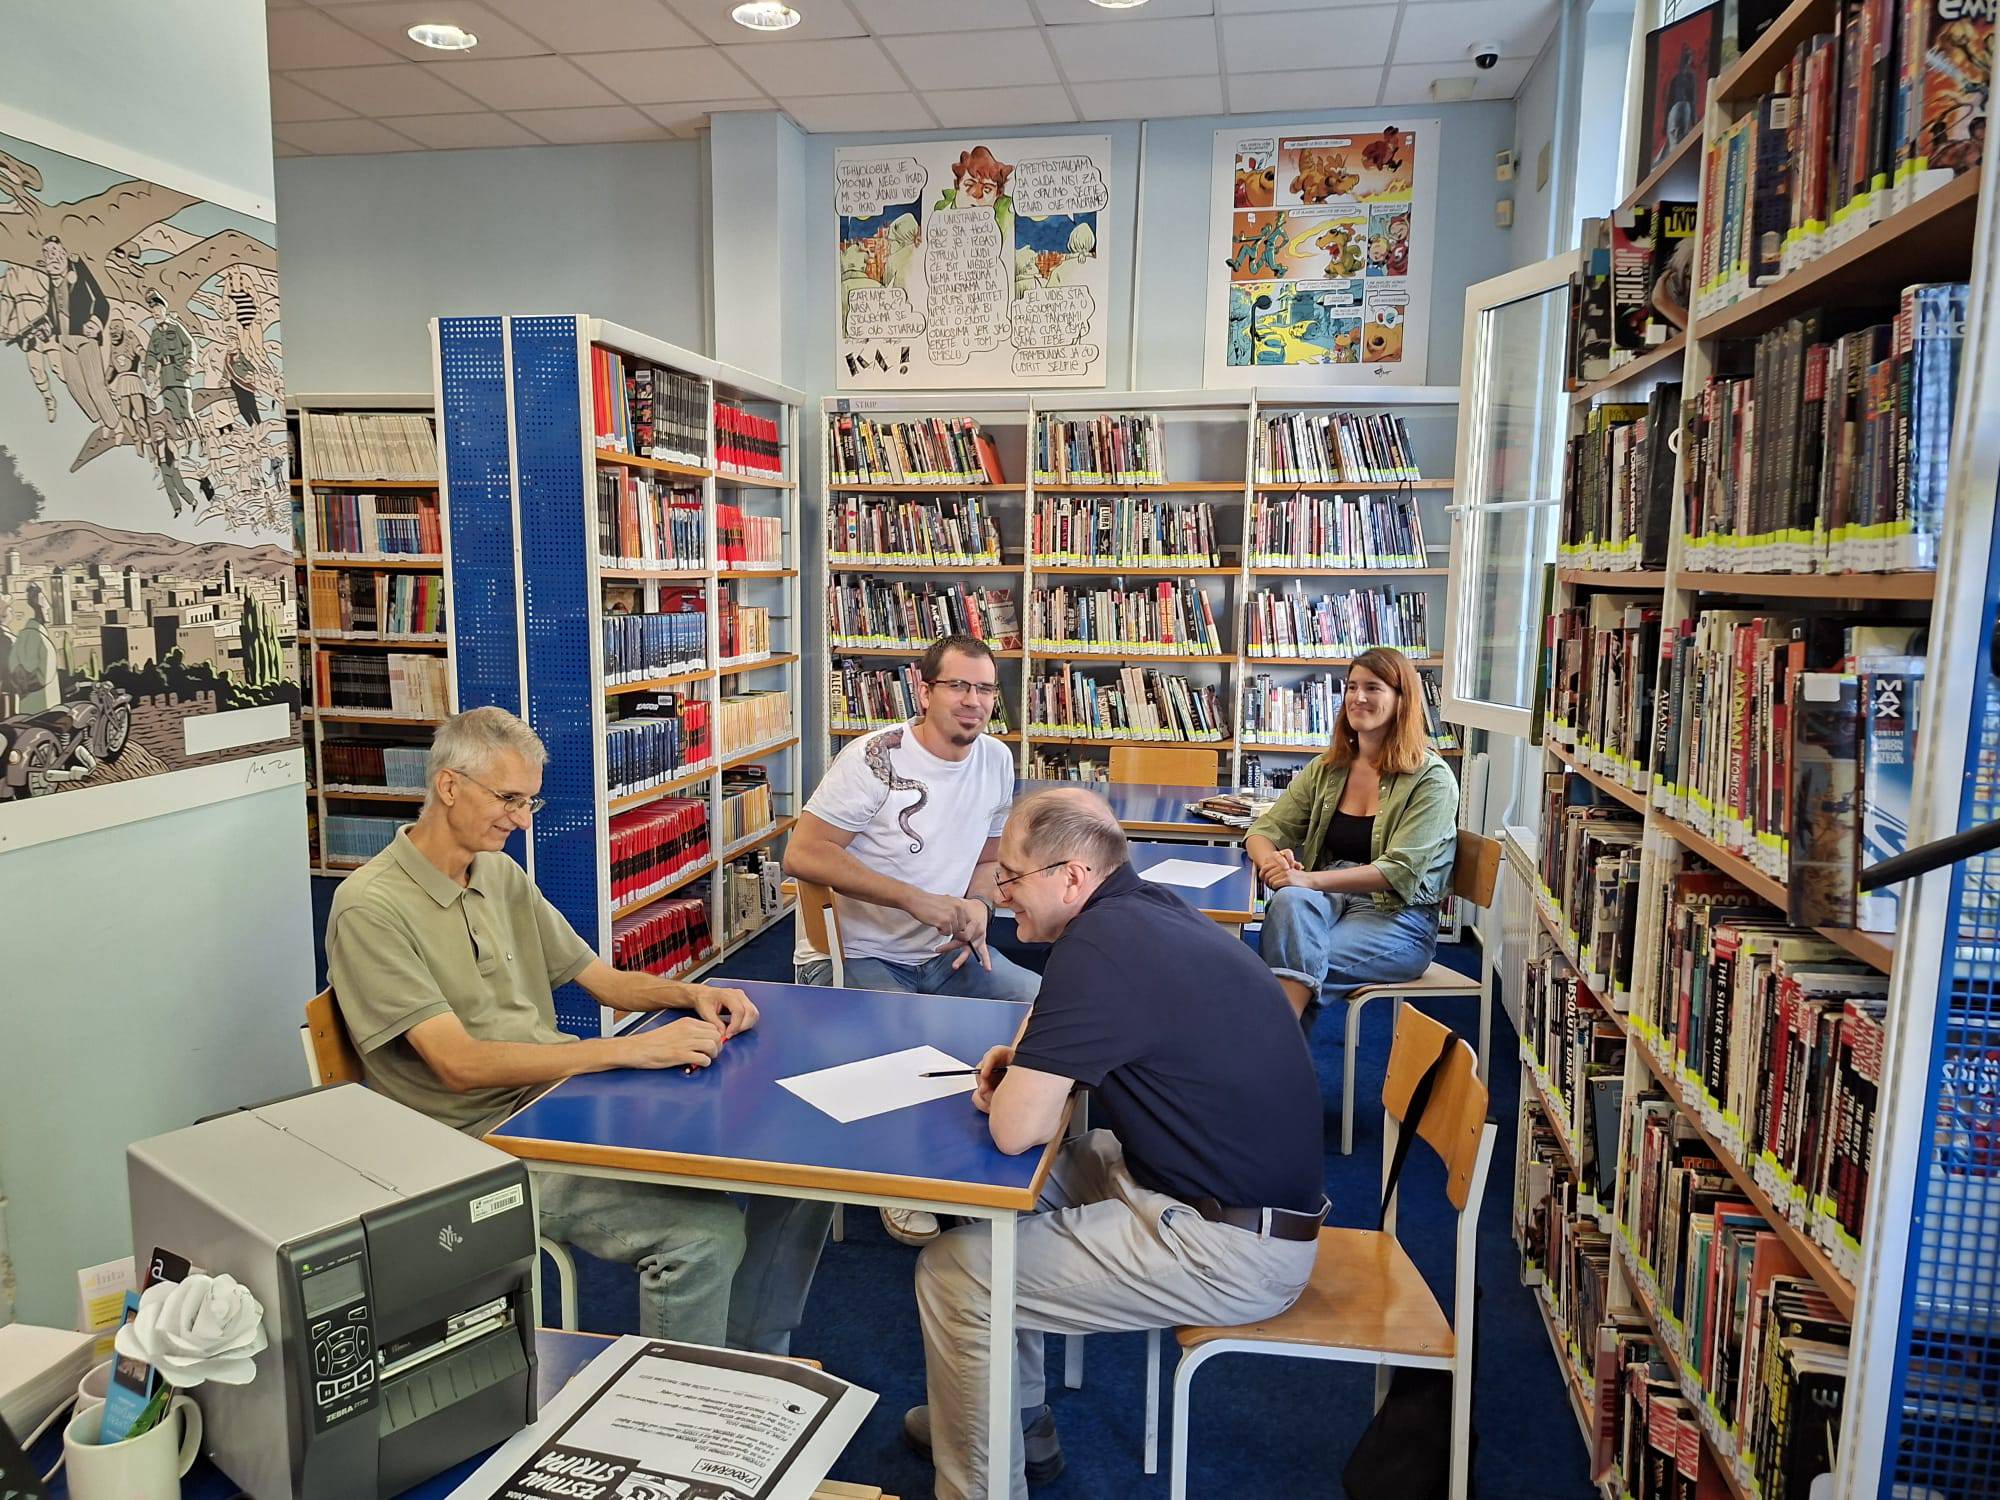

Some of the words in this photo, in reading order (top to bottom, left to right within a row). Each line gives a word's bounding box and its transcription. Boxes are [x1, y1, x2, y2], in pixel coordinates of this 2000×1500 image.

[897, 162, 907, 172] JE
[879, 176, 900, 188] NEGO
[1018, 178, 1028, 188] DA
[1062, 174, 1078, 185] NISI
[1082, 172, 1096, 184] ZA
[841, 191, 849, 202] MI
[853, 191, 870, 200] SMO
[1017, 190, 1029, 200] DA
[841, 203, 853, 213] NO
[986, 280, 997, 291] DA
[1615, 248, 1645, 306] JUSTICE
[1898, 417, 1907, 461] MARVEL
[832, 673, 842, 694] ALEC
[1731, 668, 1747, 750] MADMAN
[1657, 689, 1670, 752] ATLANTIS
[1718, 961, 1727, 987] THE
[1714, 990, 1726, 1034] SILVER
[1861, 1021, 1874, 1076] MARVEL
[1711, 1036, 1722, 1087] SURFER
[1847, 1095, 1855, 1113] THE
[1856, 1103, 1864, 1121] THE
[1845, 1115, 1853, 1139] BEST
[1853, 1124, 1861, 1149] BEST
[1843, 1142, 1850, 1155] OF
[1851, 1152, 1858, 1165] OF
[326, 1405, 354, 1423] ZEBRA
[534, 1451, 626, 1482] STRIPA
[700, 1461, 757, 1485] PROGRAM:
[518, 1472, 607, 1500] FESTIVAL
